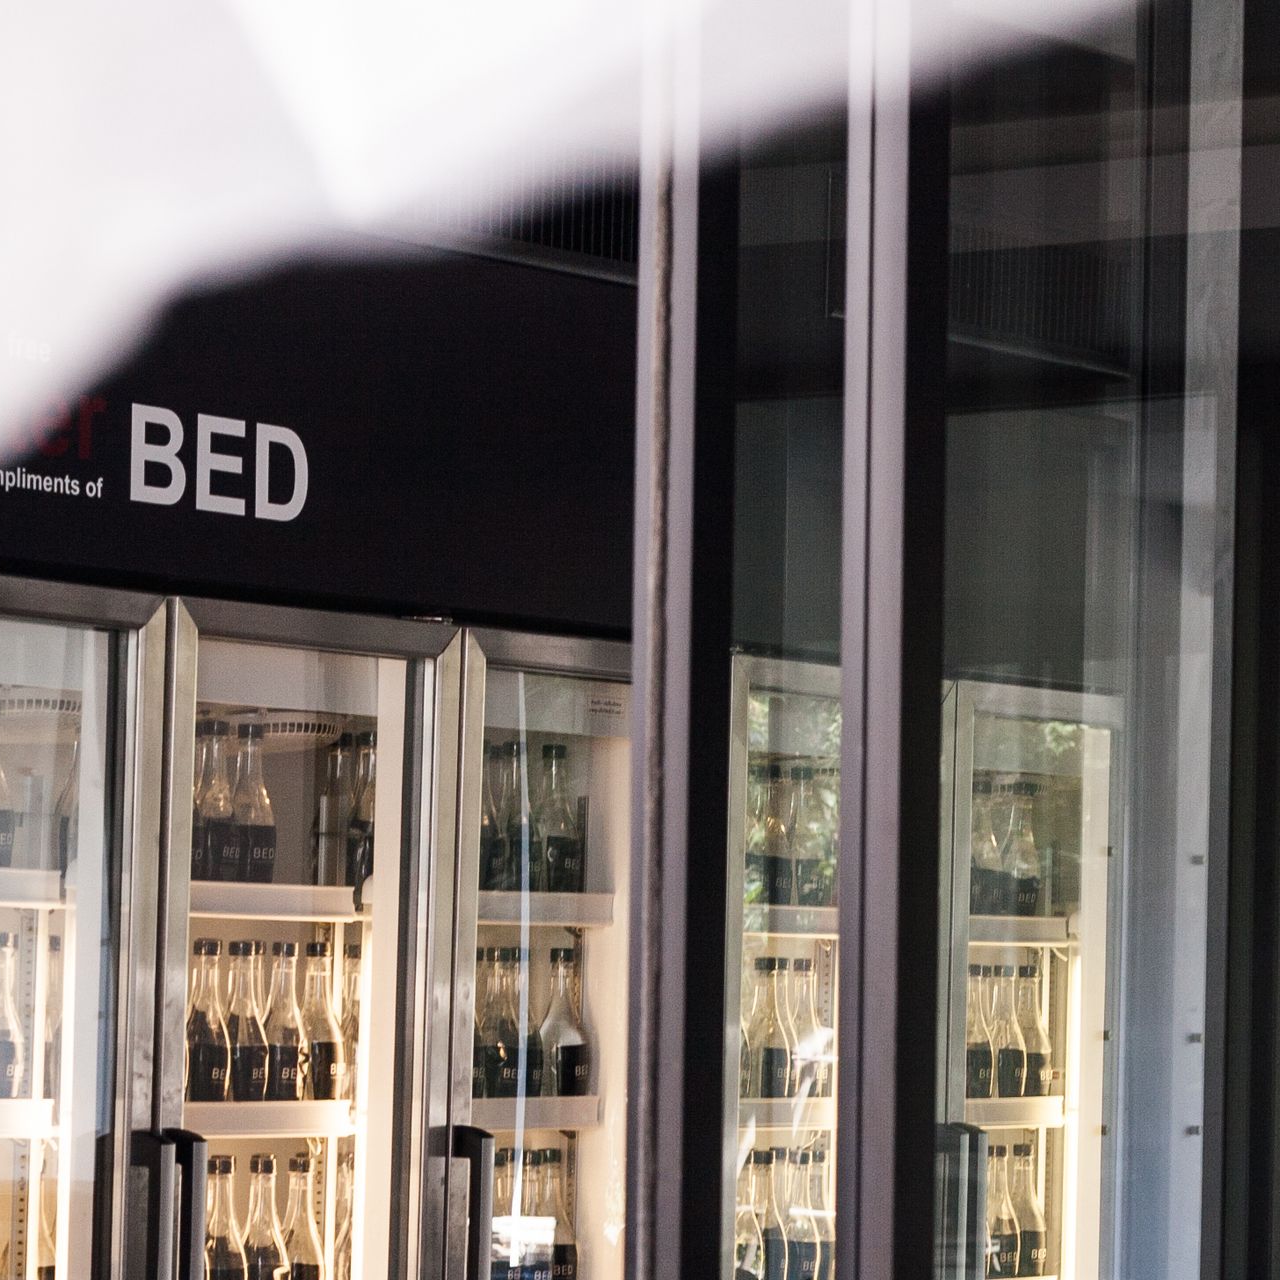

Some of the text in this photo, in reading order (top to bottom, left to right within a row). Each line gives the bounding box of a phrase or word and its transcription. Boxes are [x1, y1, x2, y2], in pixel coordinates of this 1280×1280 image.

[86, 477, 104, 499] of
[130, 402, 309, 522] BED
[253, 847, 274, 859] BED
[553, 1264, 573, 1276] BED
